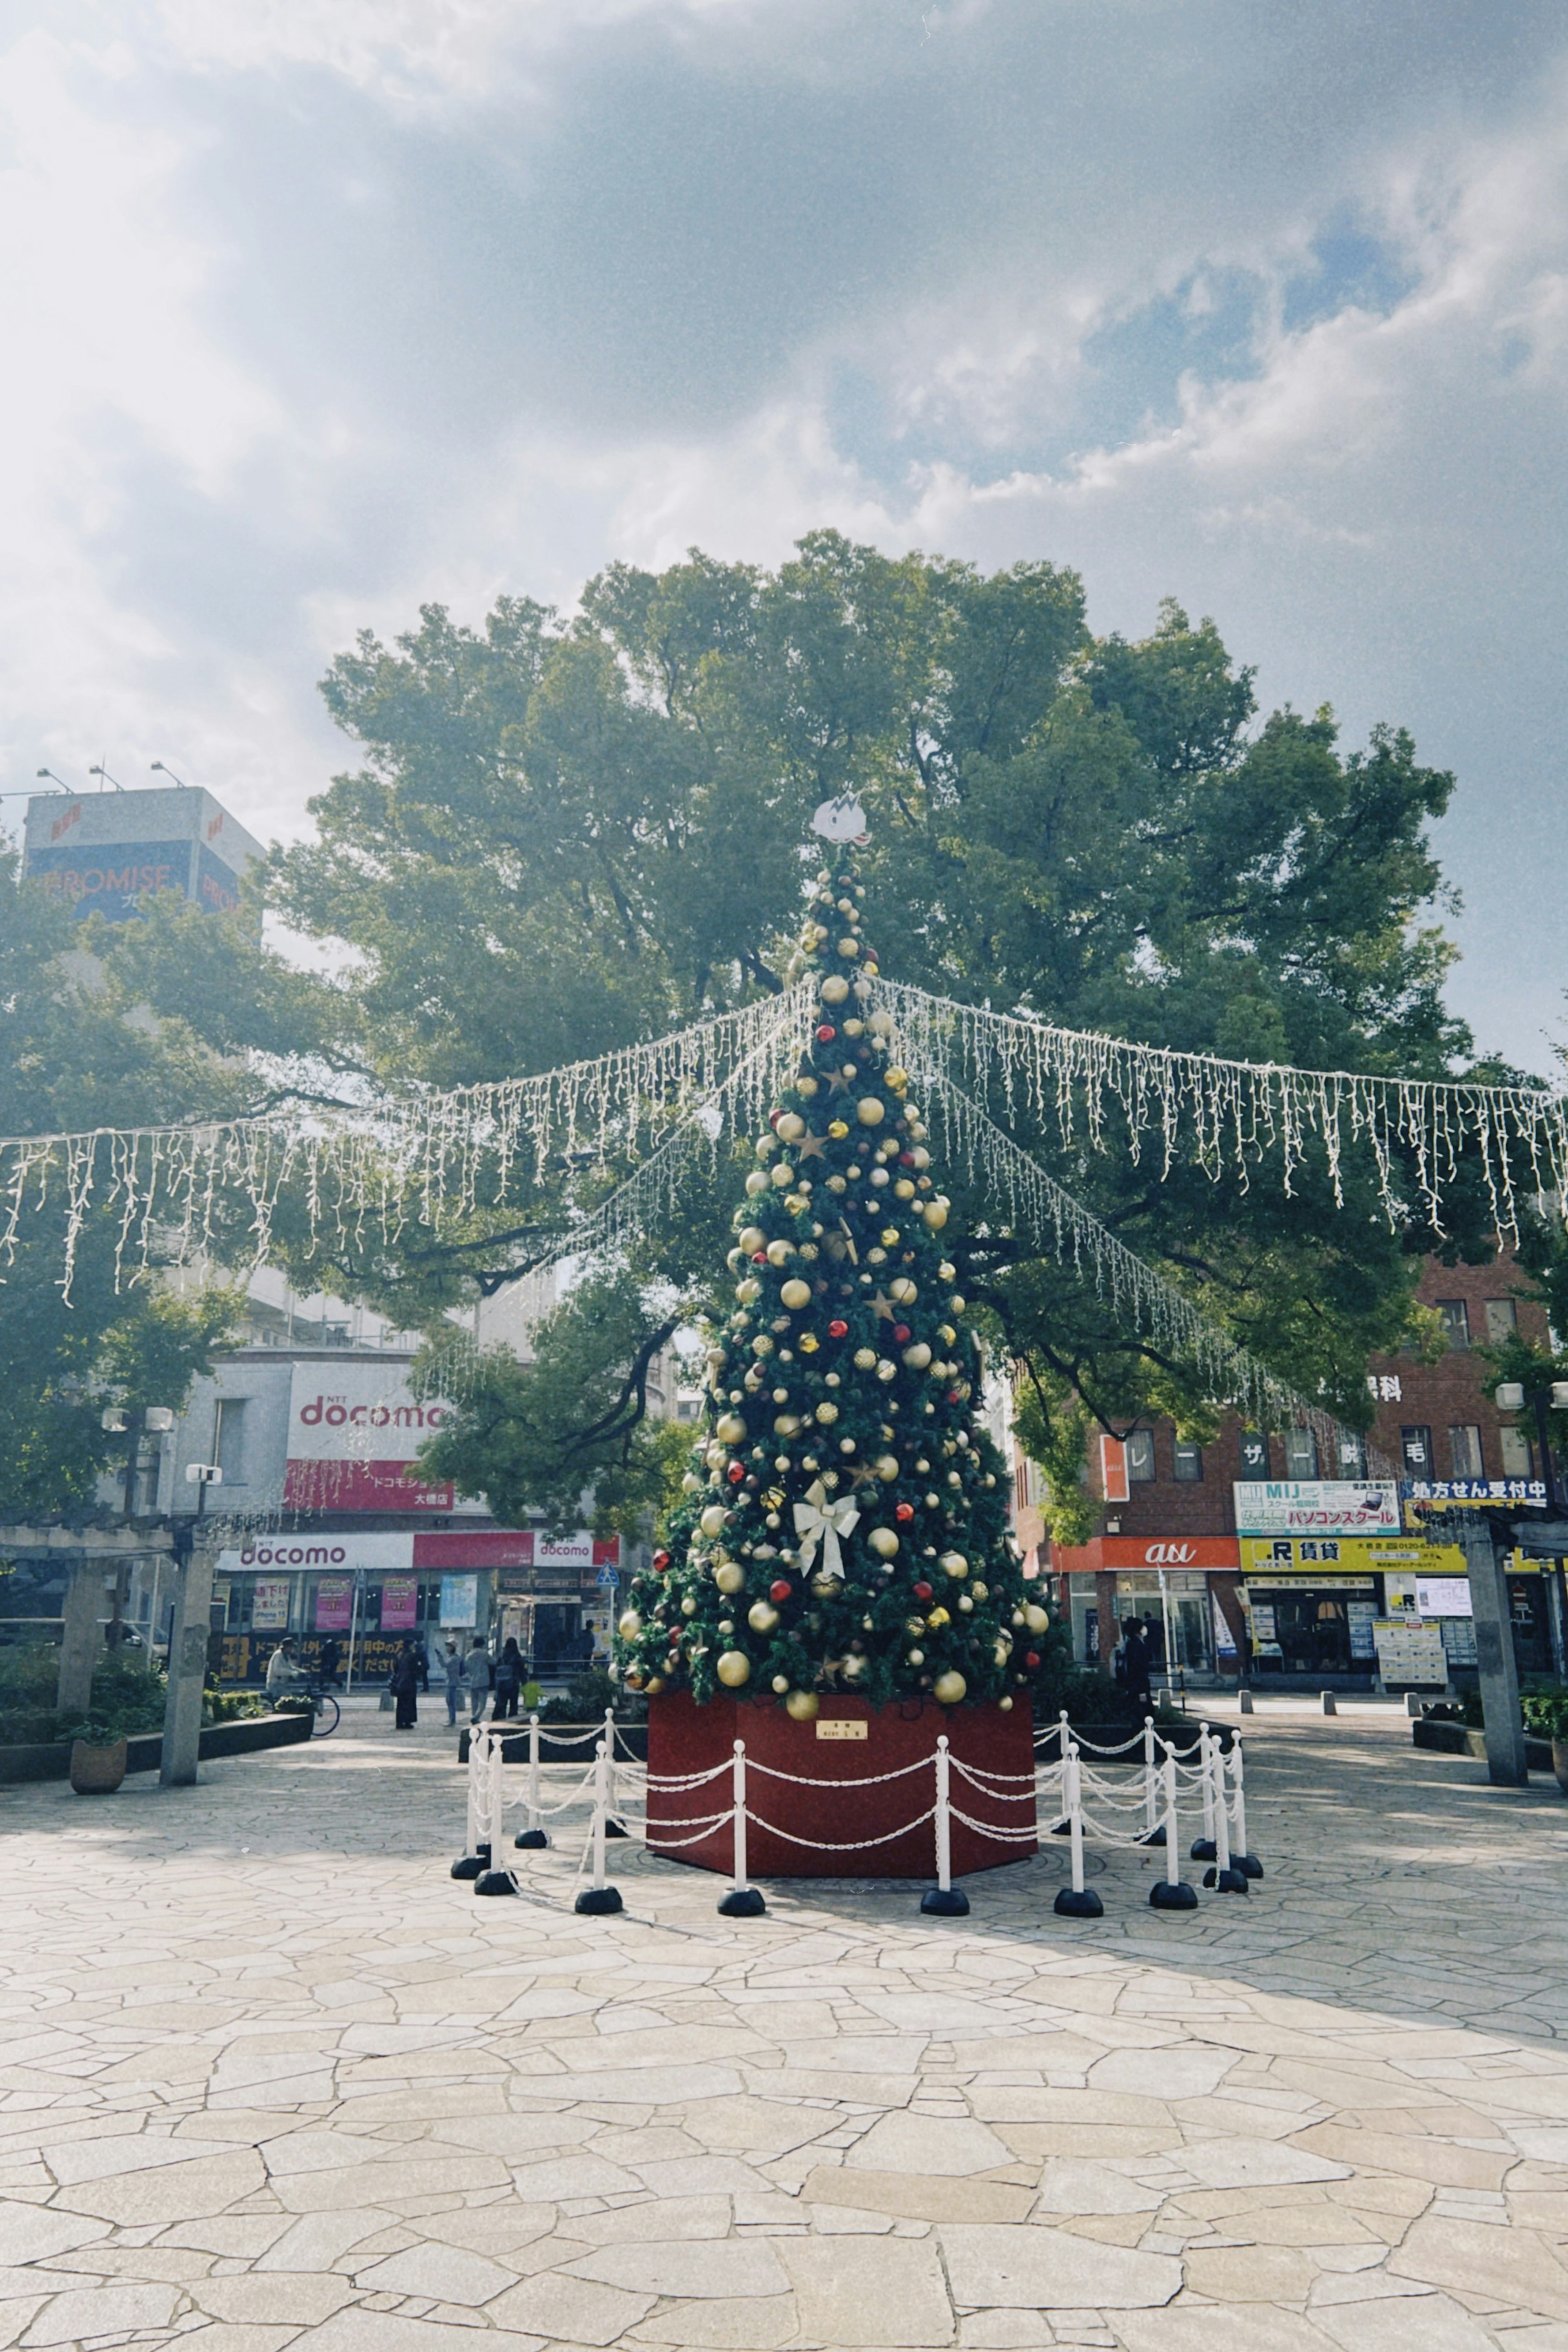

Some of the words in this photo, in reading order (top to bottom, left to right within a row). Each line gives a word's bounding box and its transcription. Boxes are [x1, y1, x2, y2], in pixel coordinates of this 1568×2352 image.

[301, 1396, 446, 1428] docomo
[1266, 1484, 1300, 1499] MIJ
[1412, 1481, 1546, 1499] 処方せん受付中
[1289, 1511, 1394, 1525] パソコンスクール
[241, 1542, 345, 1565] docomo
[541, 1544, 589, 1556] docomo
[1145, 1543, 1197, 1564] au
[1300, 1542, 1339, 1561] 賃貸
